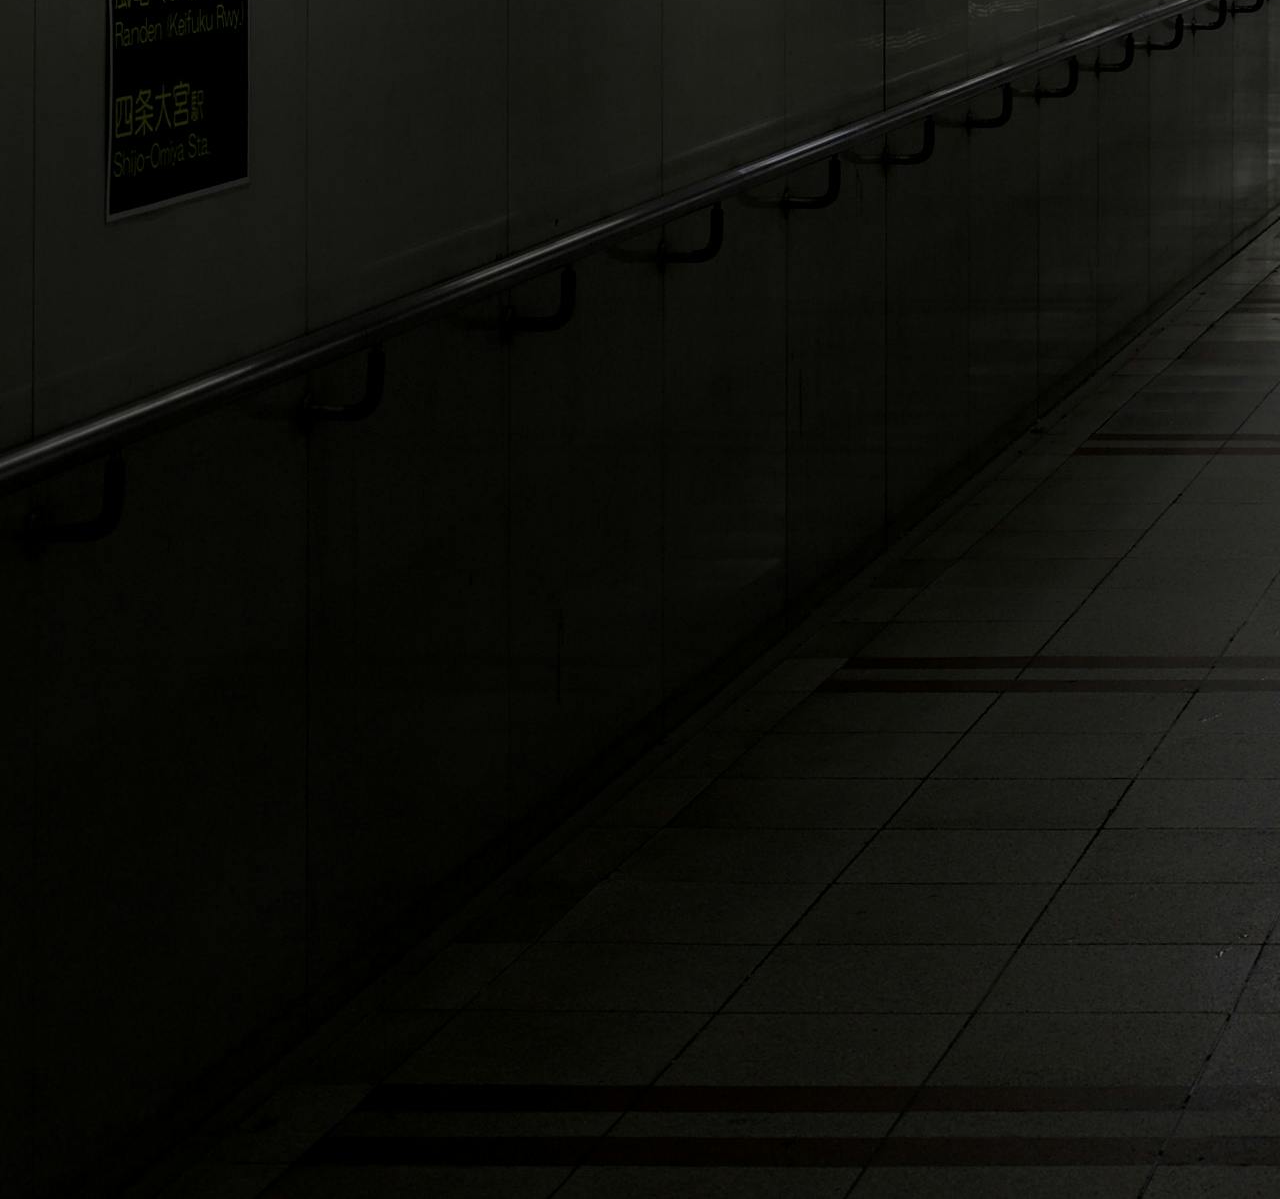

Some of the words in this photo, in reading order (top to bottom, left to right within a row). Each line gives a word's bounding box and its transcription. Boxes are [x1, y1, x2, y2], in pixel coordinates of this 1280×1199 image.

[114, 16, 163, 48] Randen
[115, 80, 206, 138] 四条大宮駅
[112, 141, 185, 178] Shijo-Omiya
